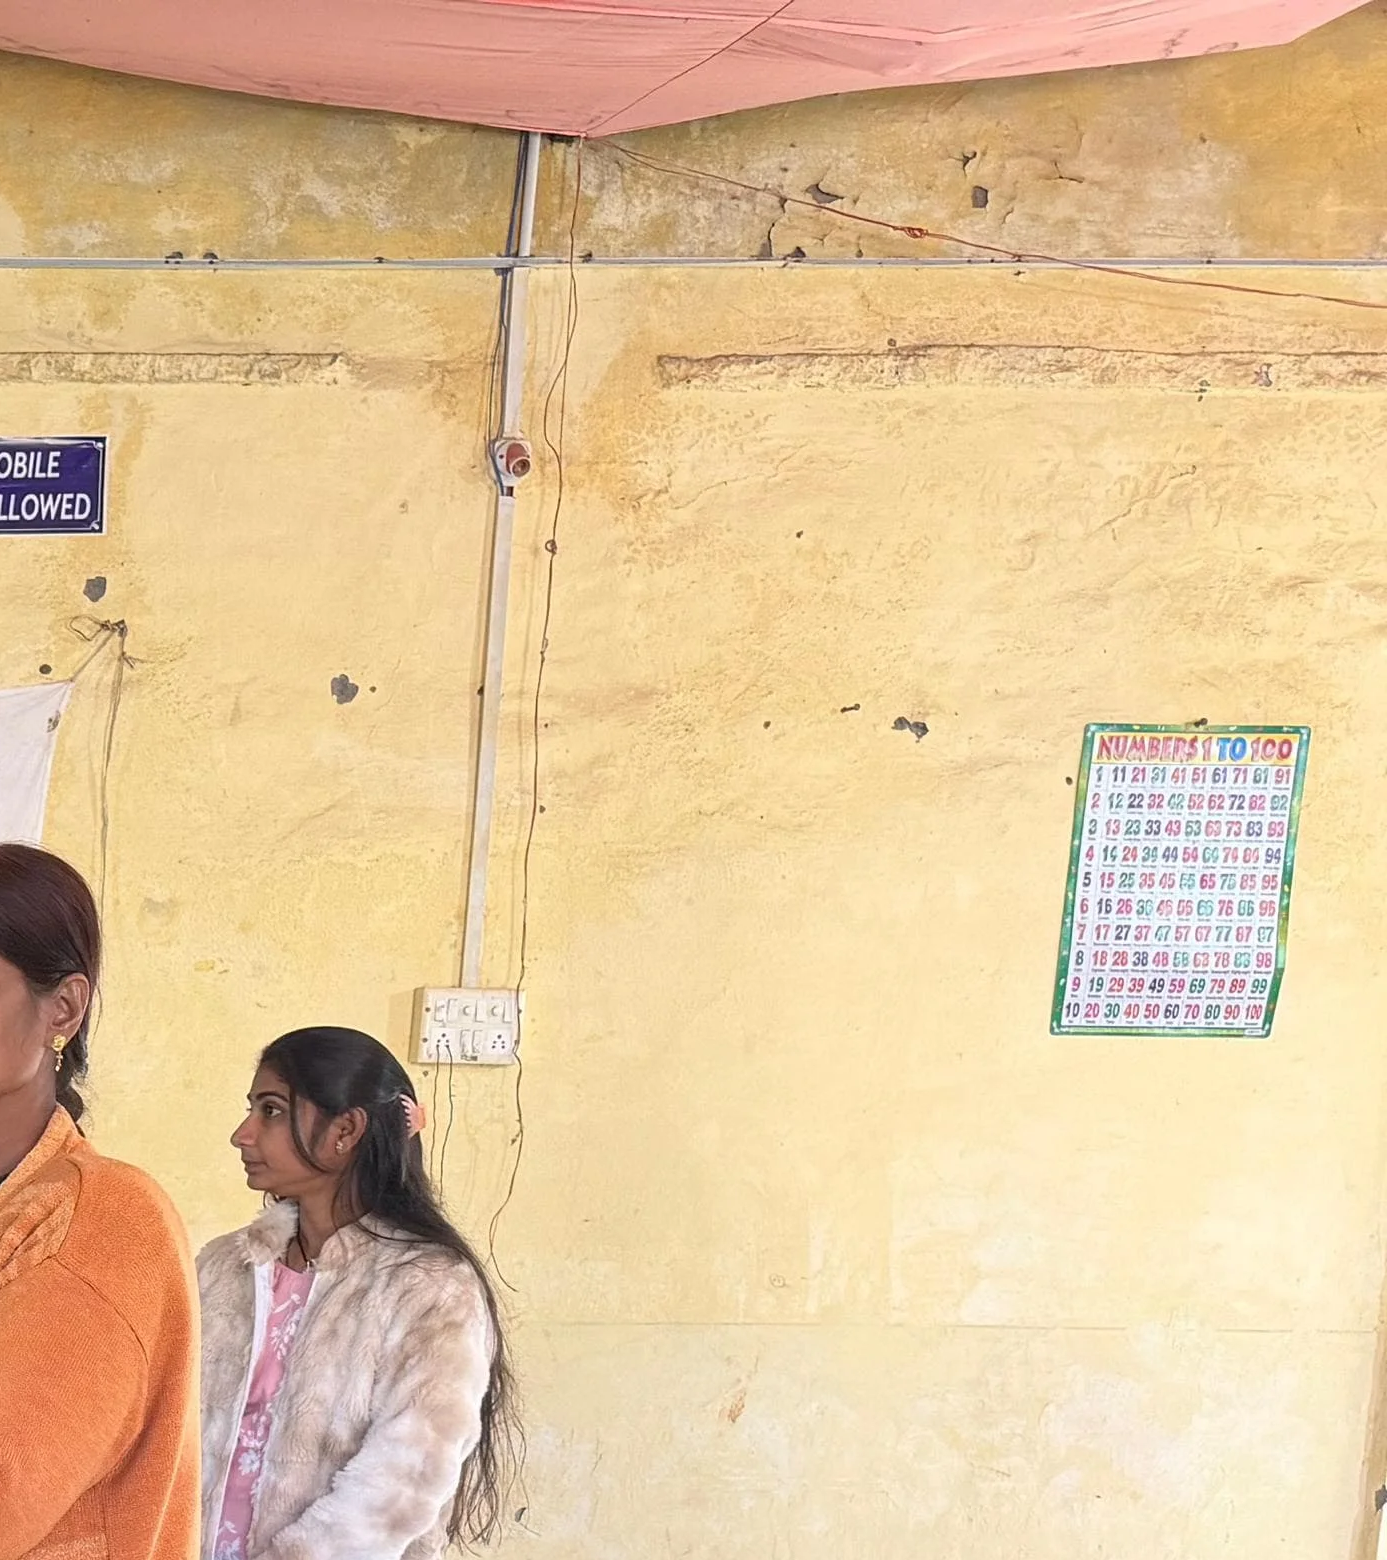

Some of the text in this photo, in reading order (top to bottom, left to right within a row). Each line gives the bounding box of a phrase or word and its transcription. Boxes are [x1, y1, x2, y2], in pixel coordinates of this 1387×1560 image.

[1096, 735, 1293, 762] NUMBERS 1 TO 100
[1096, 766, 1103, 783] 1
[1113, 766, 1126, 783] 11
[1131, 767, 1146, 783] 21
[1191, 767, 1207, 784] 51
[1212, 767, 1227, 784] 61
[1233, 768, 1248, 784] 71
[1091, 793, 1100, 810] 2
[1127, 793, 1144, 809] 22
[1147, 793, 1164, 810] 32
[1229, 794, 1245, 810] 72
[1088, 819, 1097, 835] 3
[1105, 819, 1121, 835] 13
[1124, 819, 1141, 836] 23
[1246, 821, 1263, 837] 83
[1085, 845, 1094, 861] 4
[1265, 848, 1281, 864] 94
[1083, 872, 1091, 887] 5
[1200, 873, 1216, 889] 65
[1080, 898, 1089, 914] 6
[1097, 898, 1112, 915] 16
[1115, 898, 1132, 915] 26
[1095, 924, 1110, 941] 17
[1115, 925, 1131, 941] 27
[1075, 950, 1084, 966] 8
[1093, 951, 1108, 966] 18
[1112, 951, 1128, 966] 28
[1132, 951, 1148, 967] 38
[1253, 952, 1271, 968] 98
[1072, 976, 1267, 994] 9 19 29 39 49 59 69 79 89 99
[1066, 1002, 1263, 1020] 10 20 30 40 50 60 70 80 90 100
